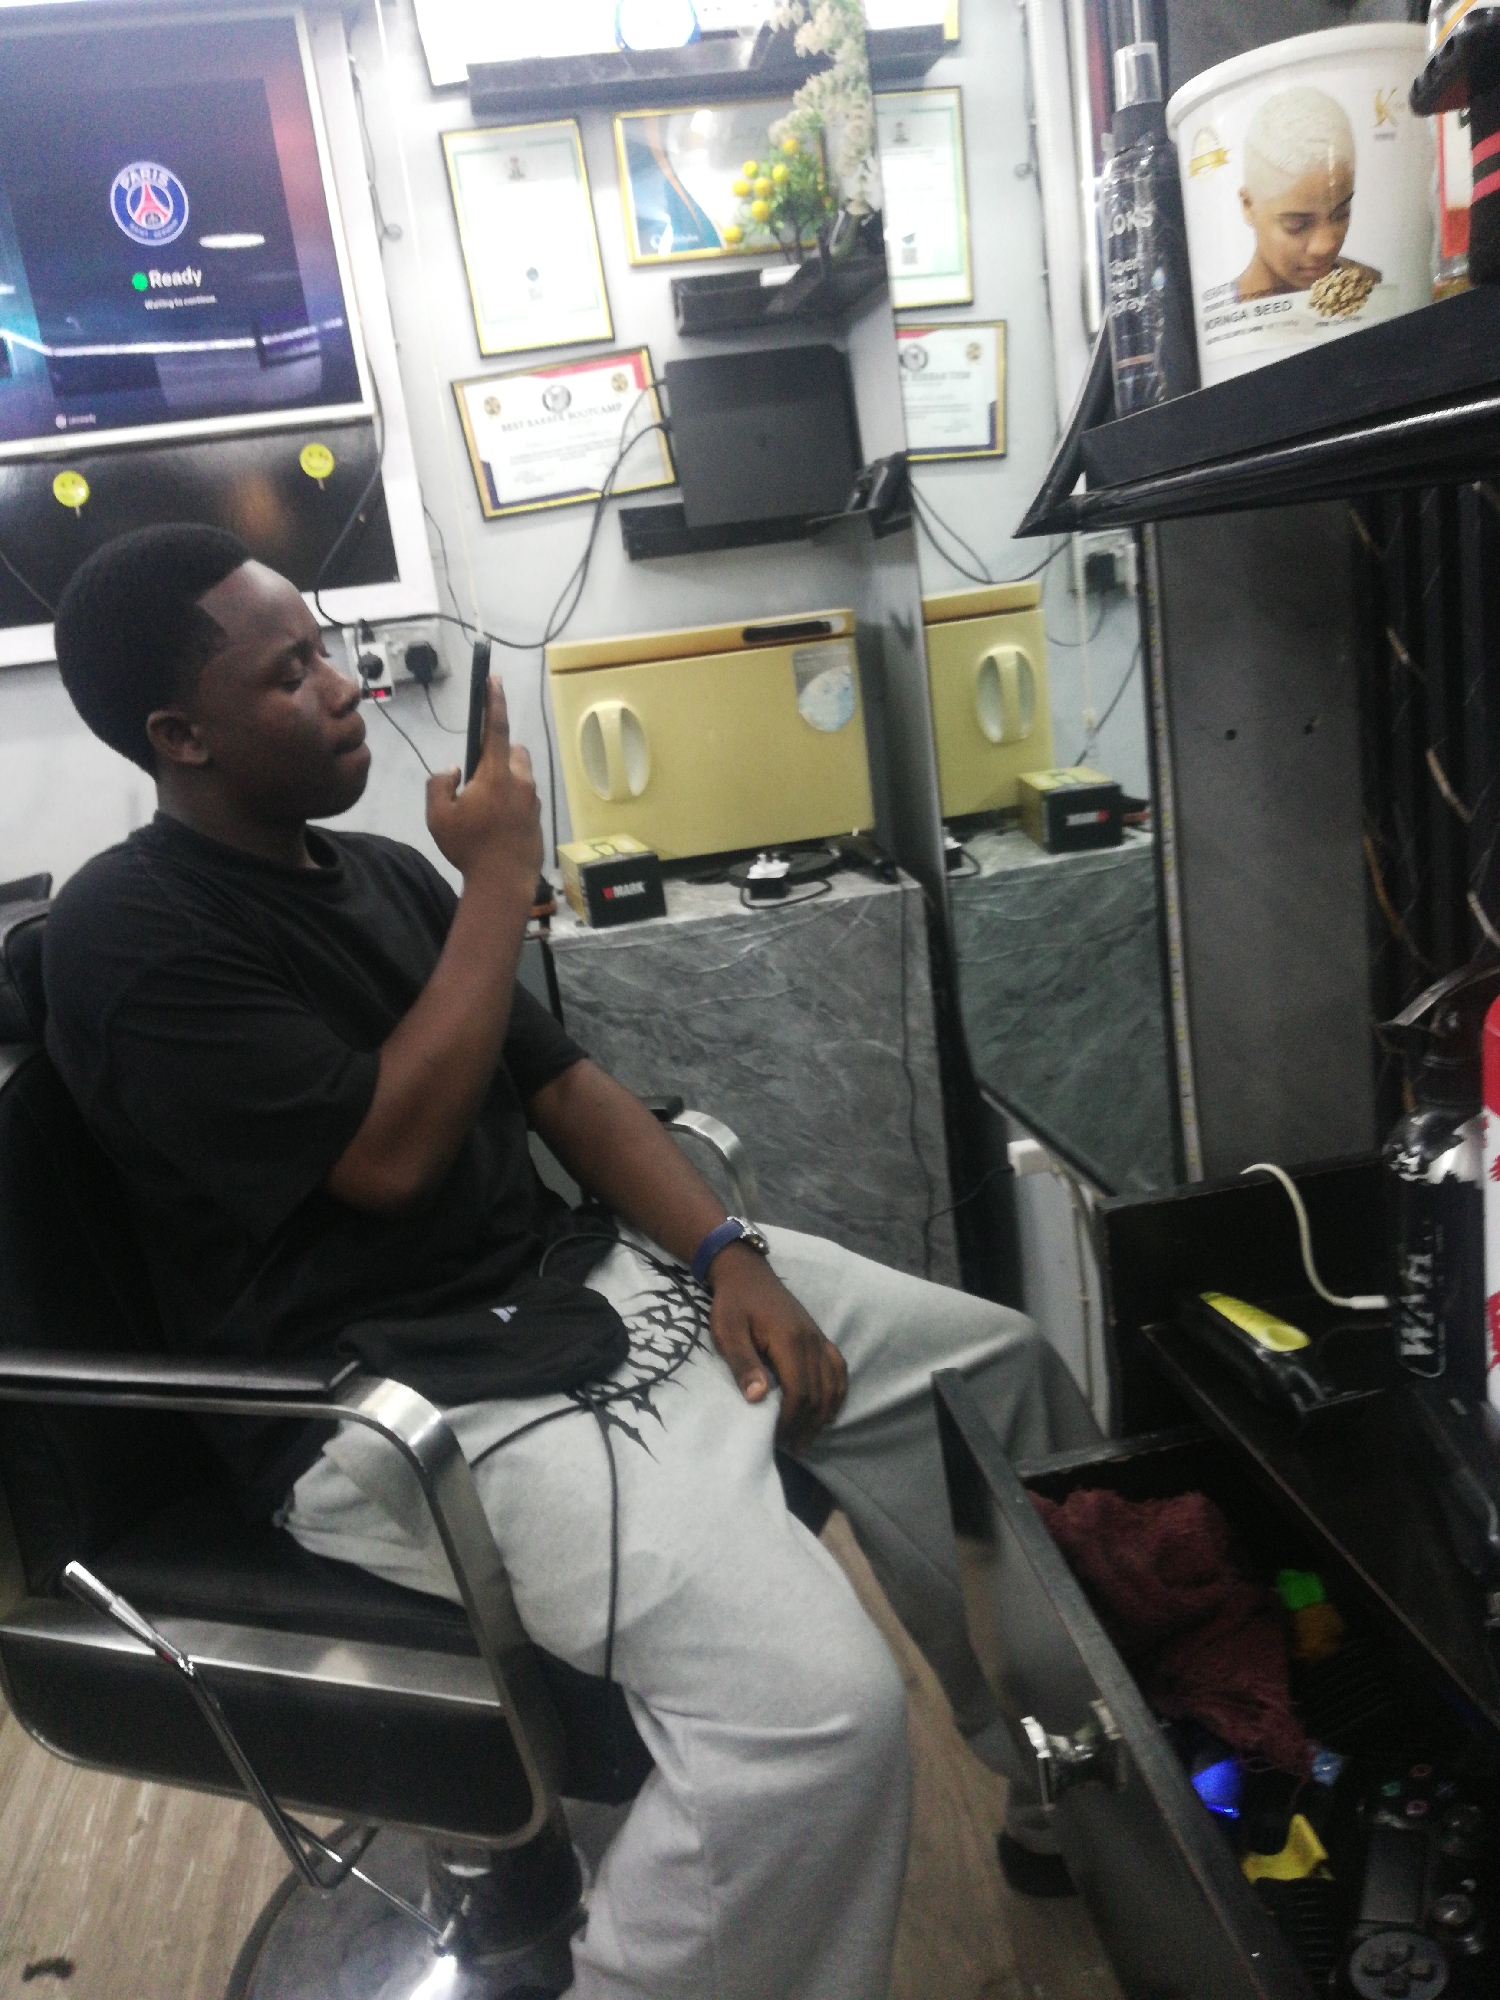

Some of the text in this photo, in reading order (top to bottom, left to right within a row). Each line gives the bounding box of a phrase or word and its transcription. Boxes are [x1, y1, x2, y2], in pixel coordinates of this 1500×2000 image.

[148, 265, 202, 289] Ready
[1253, 299, 1294, 317] SEED
[567, 402, 623, 420] BOOTCAMP
